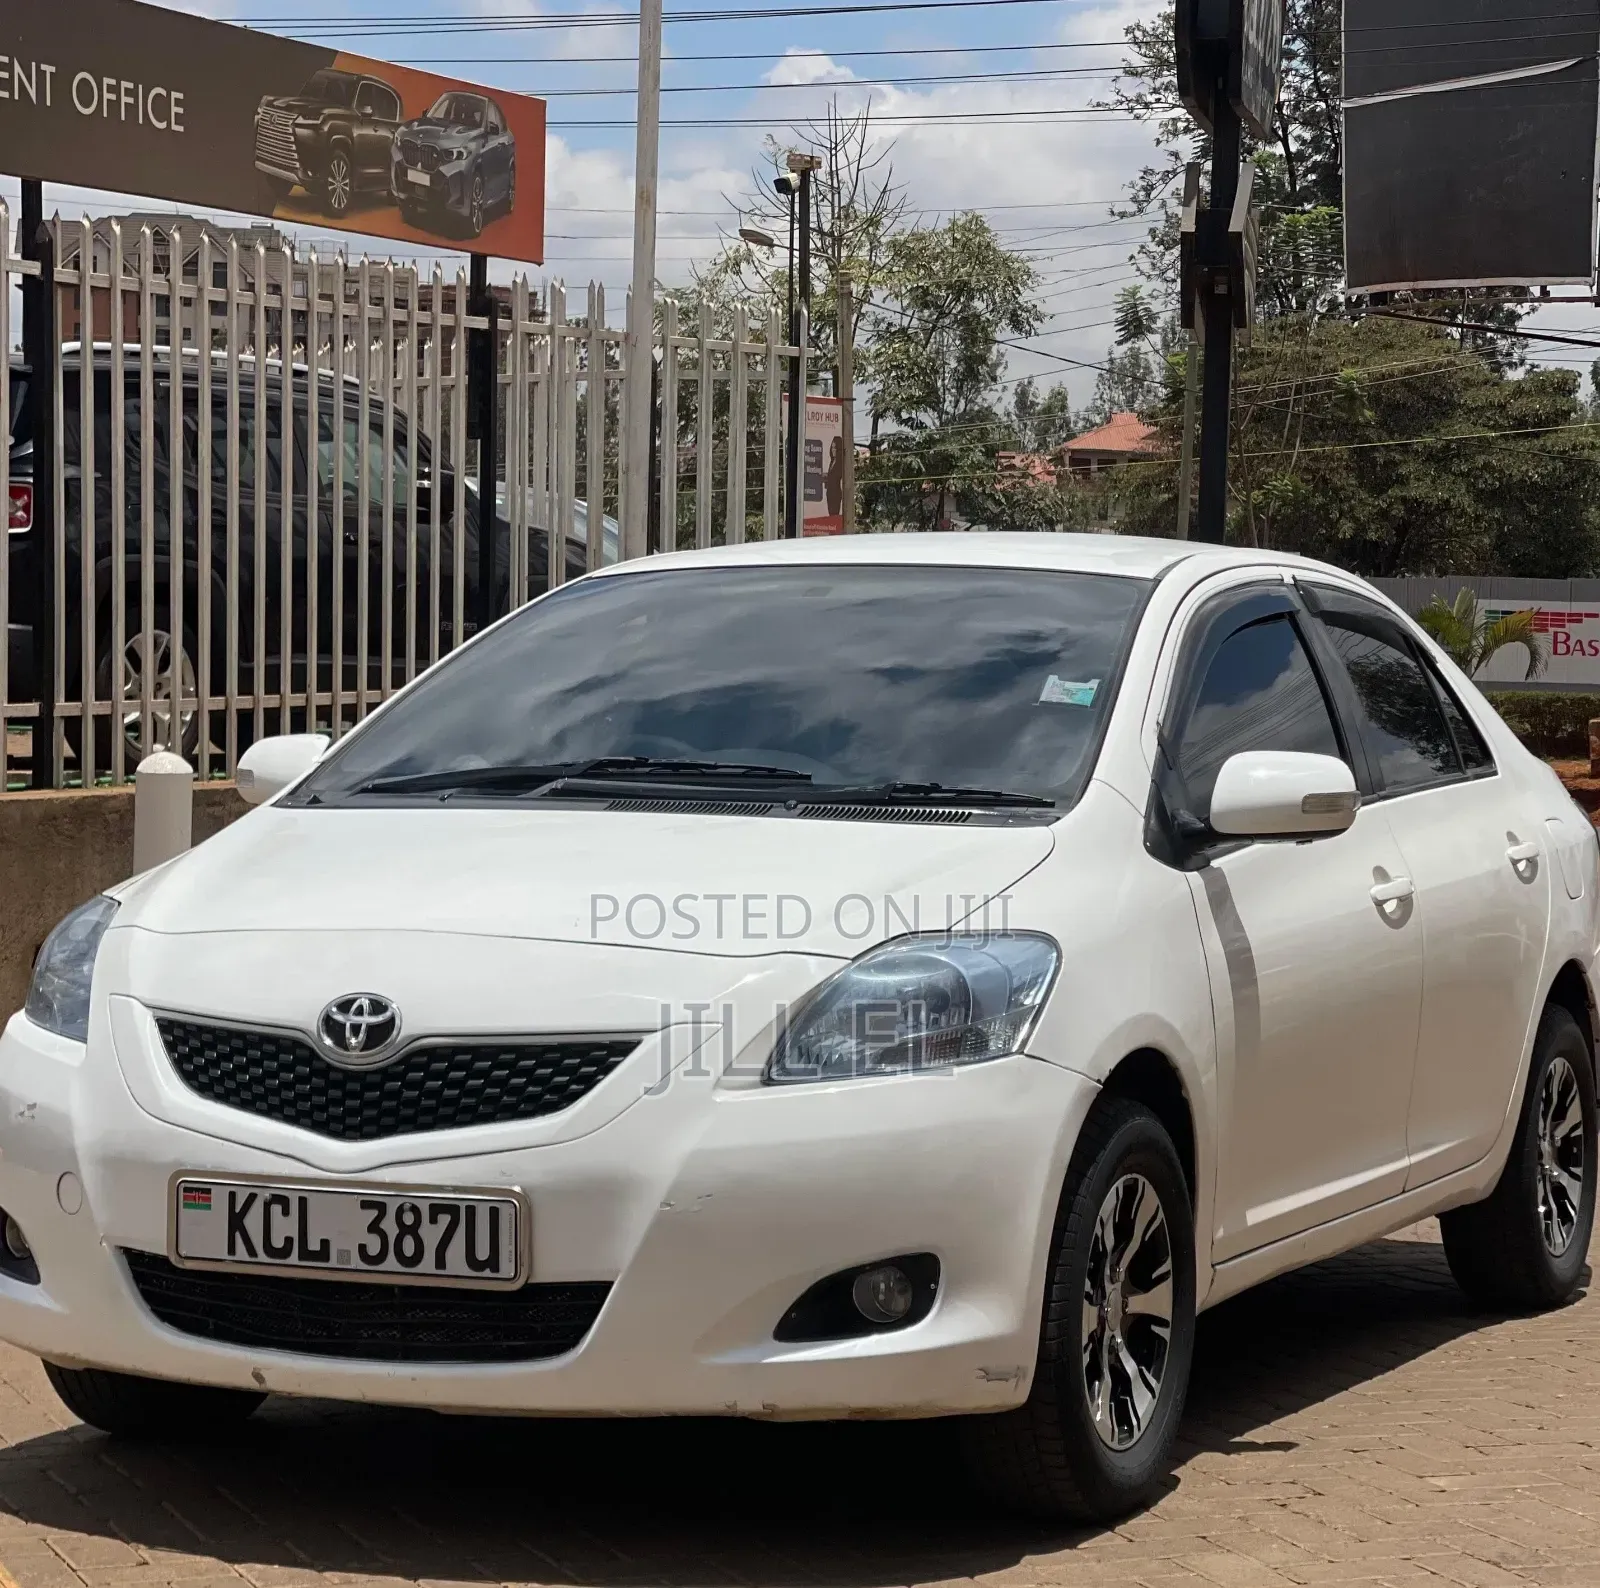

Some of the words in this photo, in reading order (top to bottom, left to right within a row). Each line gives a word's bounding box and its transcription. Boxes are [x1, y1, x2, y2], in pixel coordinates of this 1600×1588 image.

[0, 55, 56, 107] ENT
[72, 71, 184, 132] OFFICE
[825, 412, 839, 423] HUB
[227, 1189, 331, 1264] KCL
[357, 1198, 501, 1274] 387U
